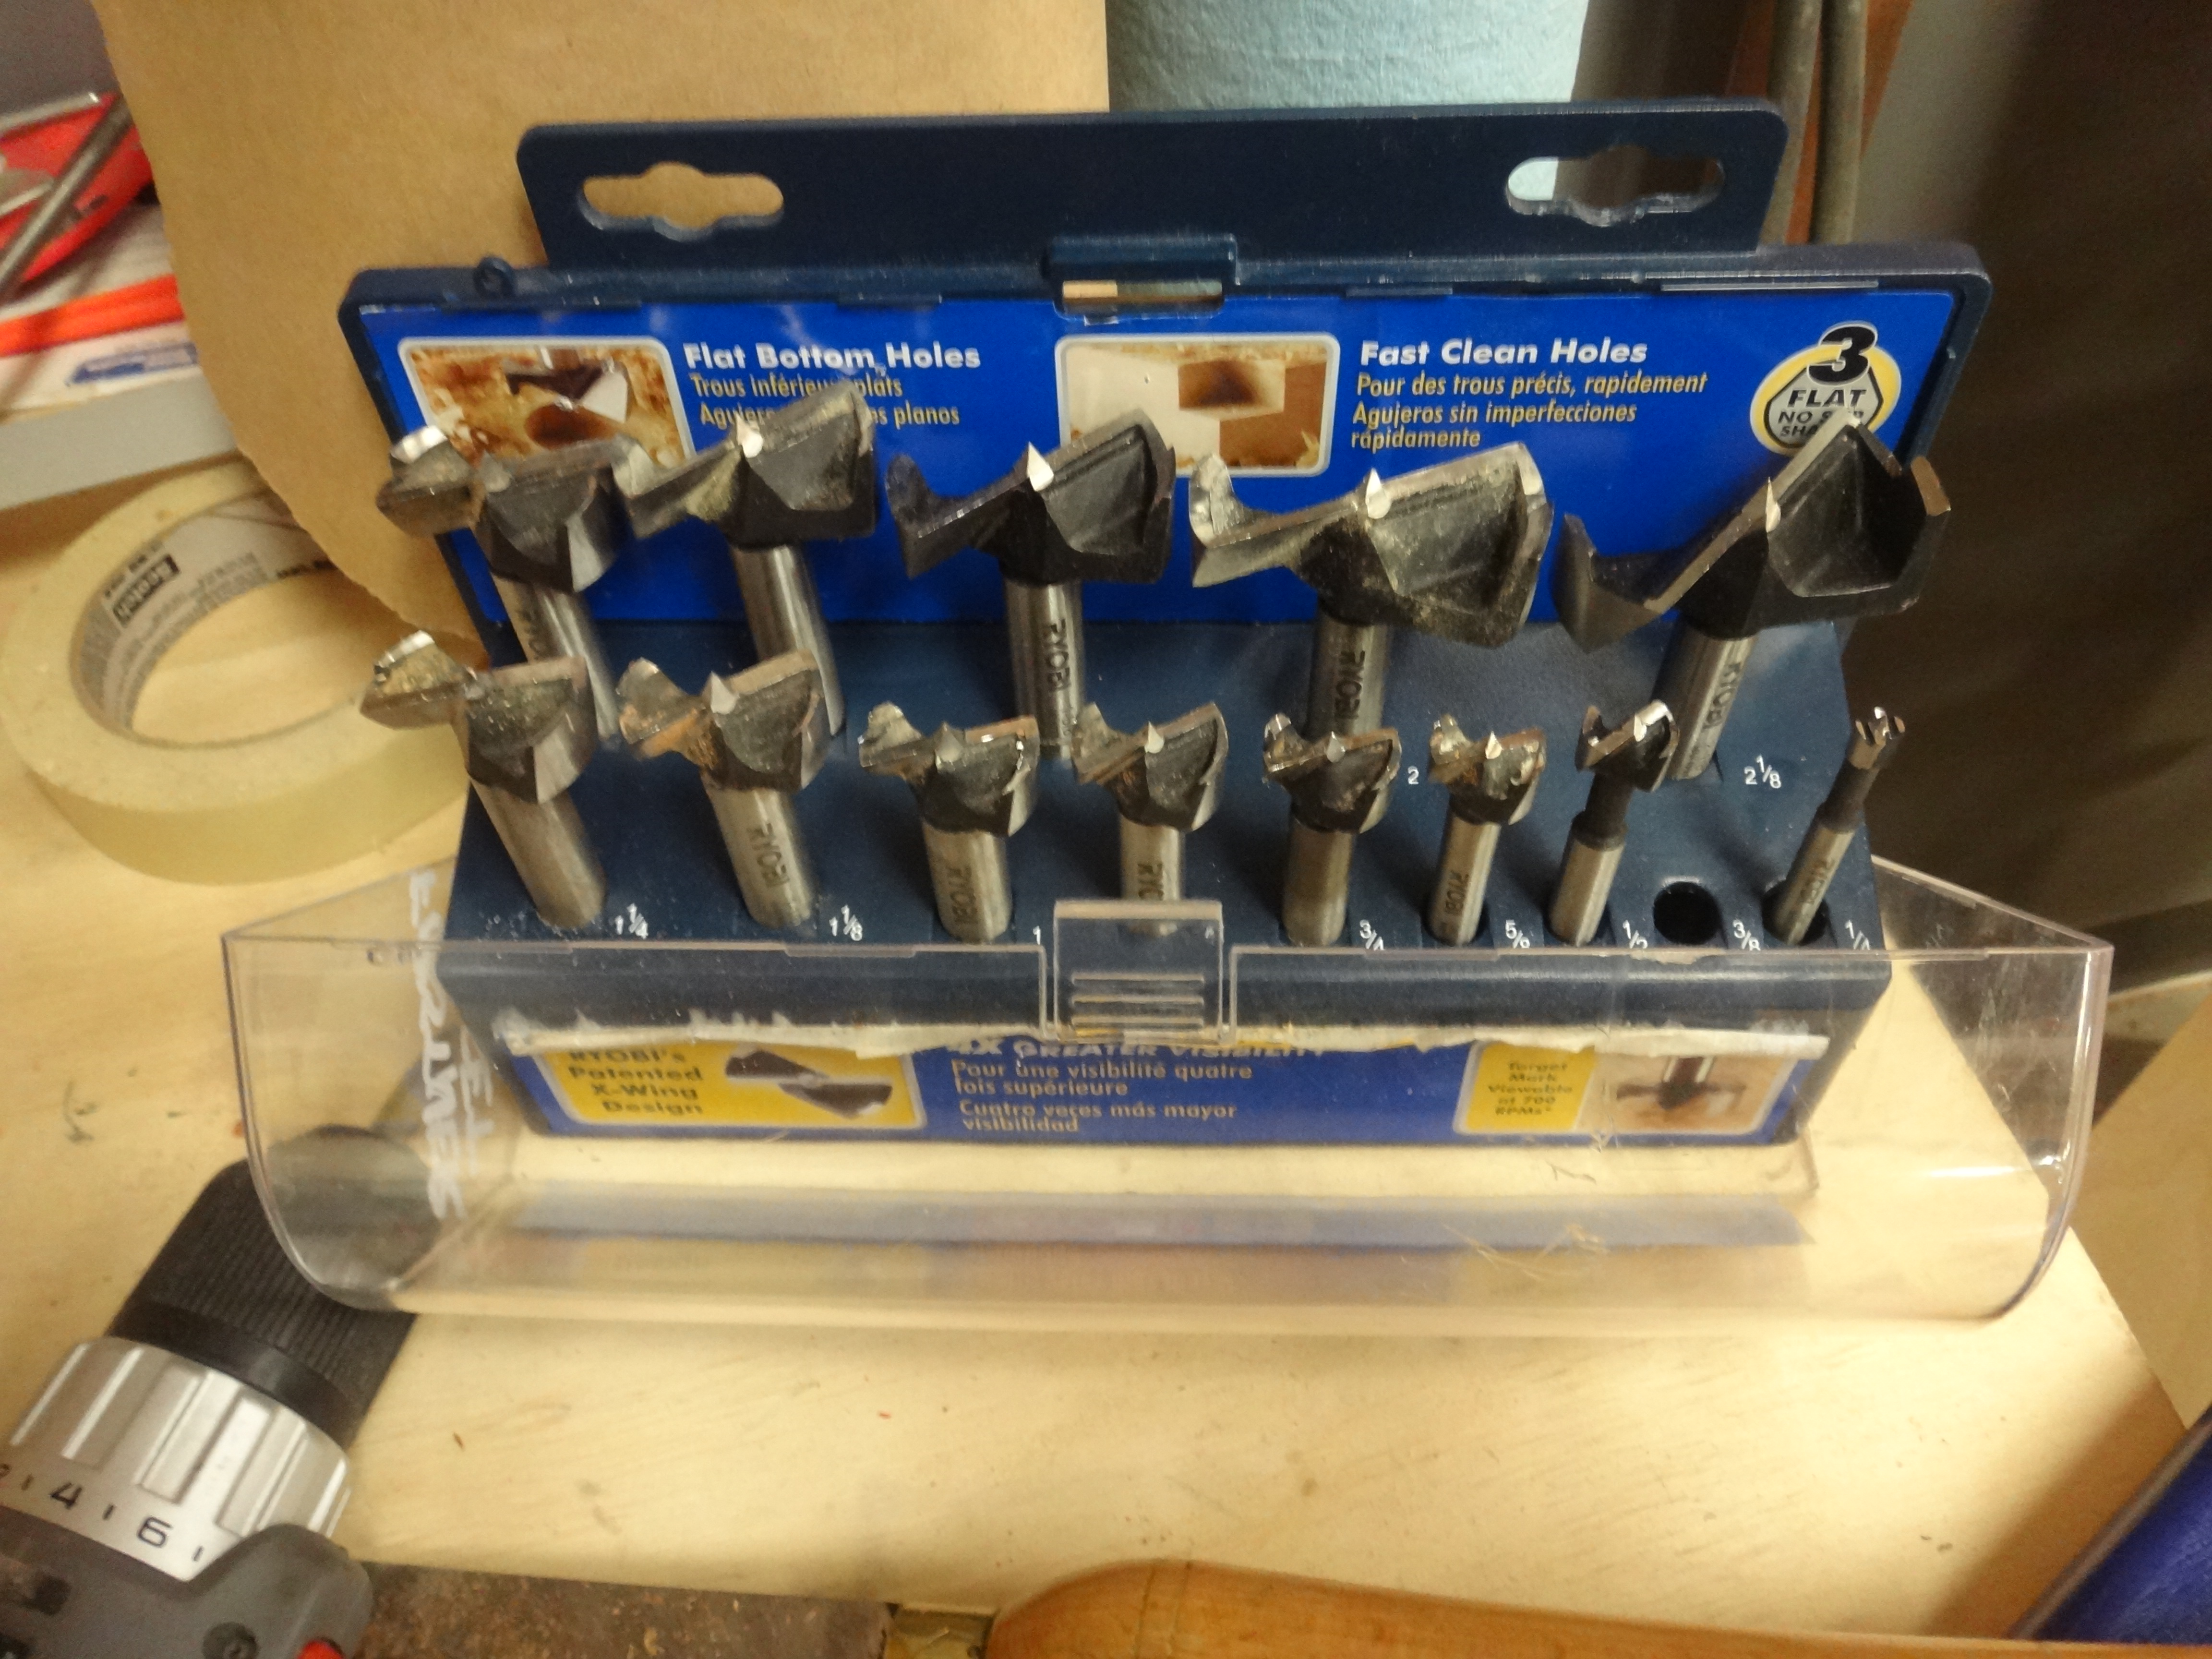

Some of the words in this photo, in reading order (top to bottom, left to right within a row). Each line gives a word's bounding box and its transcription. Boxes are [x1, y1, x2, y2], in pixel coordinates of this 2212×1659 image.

[683, 341, 746, 369] Flat
[756, 342, 875, 369] Bottom
[885, 341, 981, 369] Holes
[1360, 340, 1430, 366] Fast
[1441, 337, 1538, 364] Clean
[1550, 336, 1648, 365] Holes
[1808, 325, 1876, 384] 3
[689, 372, 746, 397] Trous
[1357, 372, 1405, 397] Pour
[1411, 370, 1446, 396] des
[1453, 373, 1504, 396] trous
[1510, 370, 1576, 399] précis,
[1583, 368, 1708, 398] rapidement
[1787, 389, 1867, 408] FLAT
[894, 399, 960, 430] planos
[1352, 401, 1443, 430] Agujeros
[1449, 401, 1479, 423] sin
[1485, 398, 1637, 428] imperfecciones
[1778, 411, 1813, 424] NO
[1351, 425, 1481, 453] rápidamente
[1407, 766, 1419, 785] 2
[1744, 767, 1758, 785] 2
[614, 914, 625, 936] 1
[828, 916, 838, 937] 1
[568, 1066, 703, 1081] Patented
[951, 1058, 1005, 1077] Pour
[1174, 1063, 1253, 1083] quatre
[602, 1101, 703, 1115] Design
[1163, 1105, 1237, 1122] mayor
[50, 1481, 83, 1510] 4
[136, 1516, 173, 1549] 6
